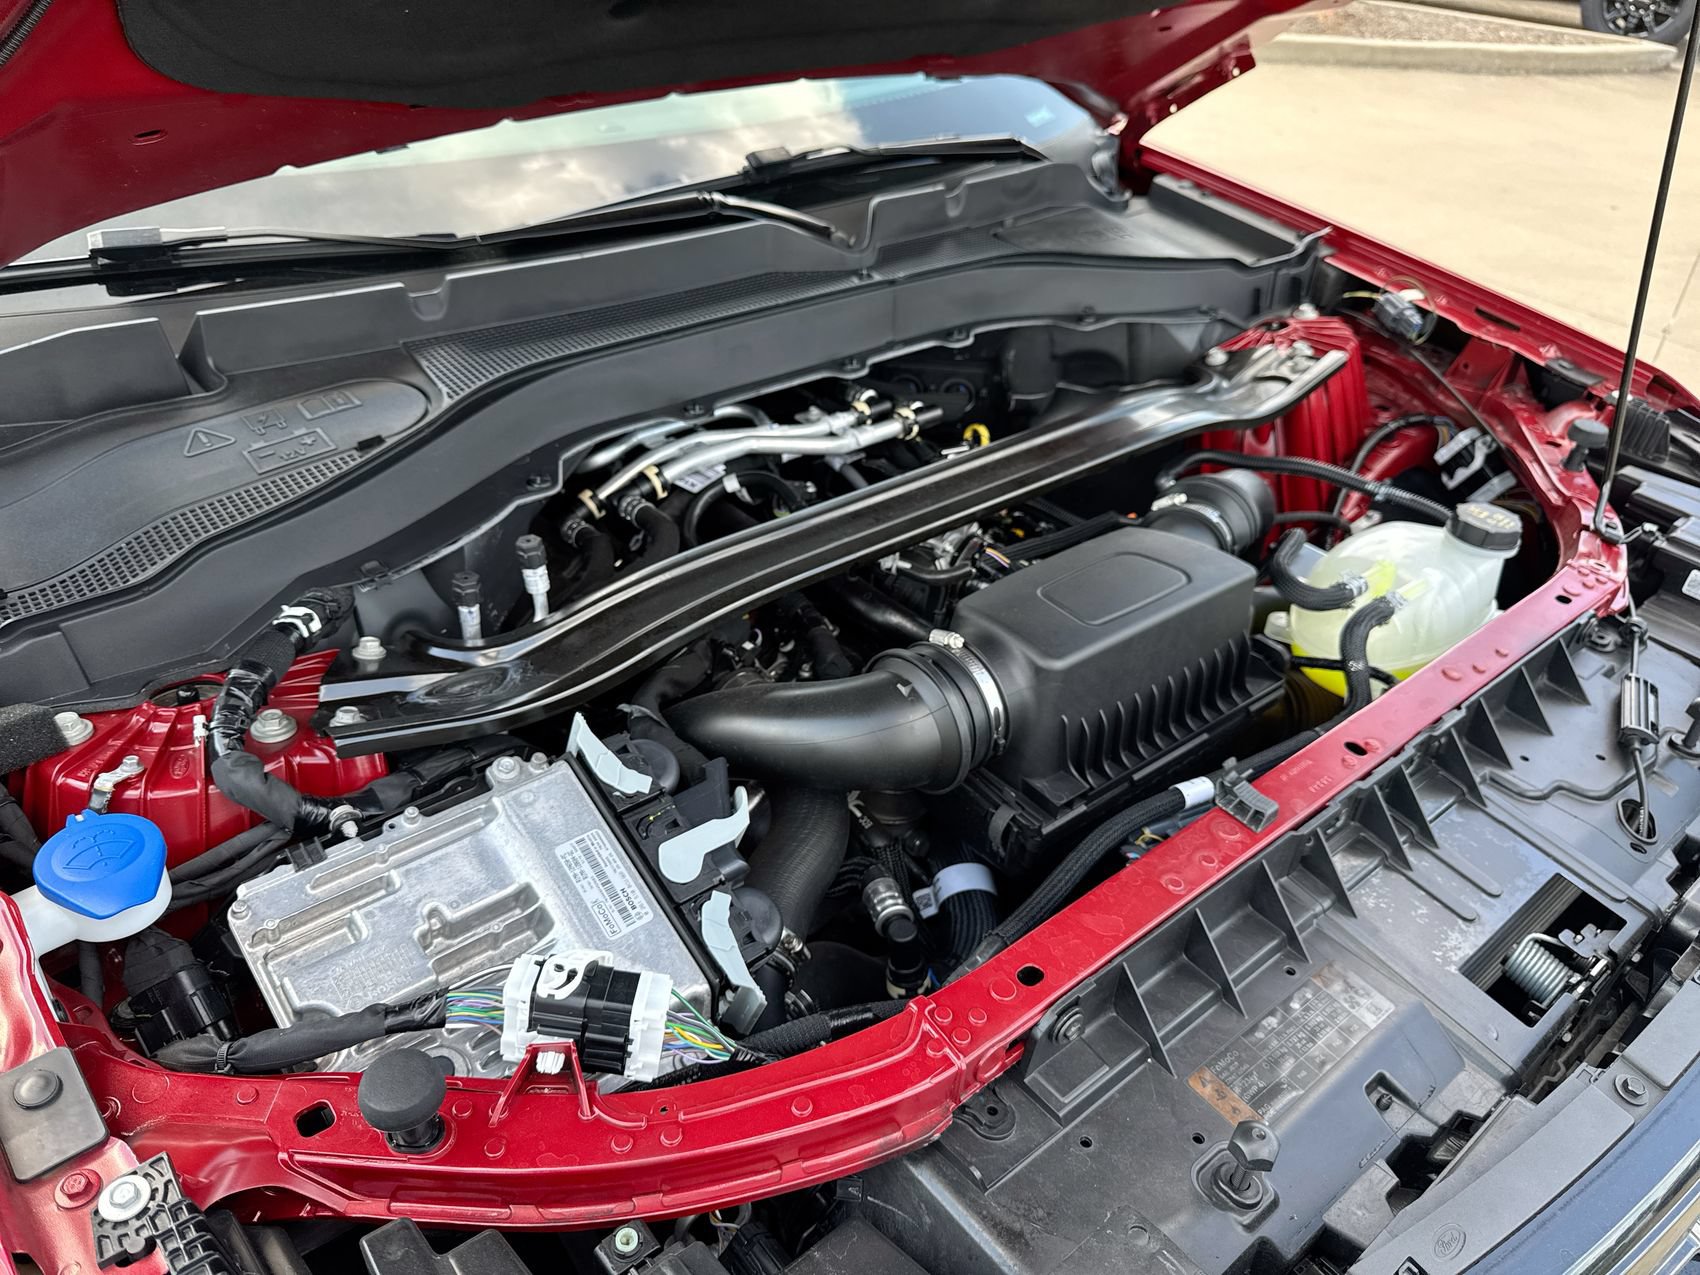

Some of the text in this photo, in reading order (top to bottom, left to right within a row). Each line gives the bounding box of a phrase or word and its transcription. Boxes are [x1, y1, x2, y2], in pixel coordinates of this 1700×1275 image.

[620, 888, 637, 911] BOSCH
[597, 904, 618, 935] FoMoCo
[1210, 1050, 1239, 1074] FoMoCo
